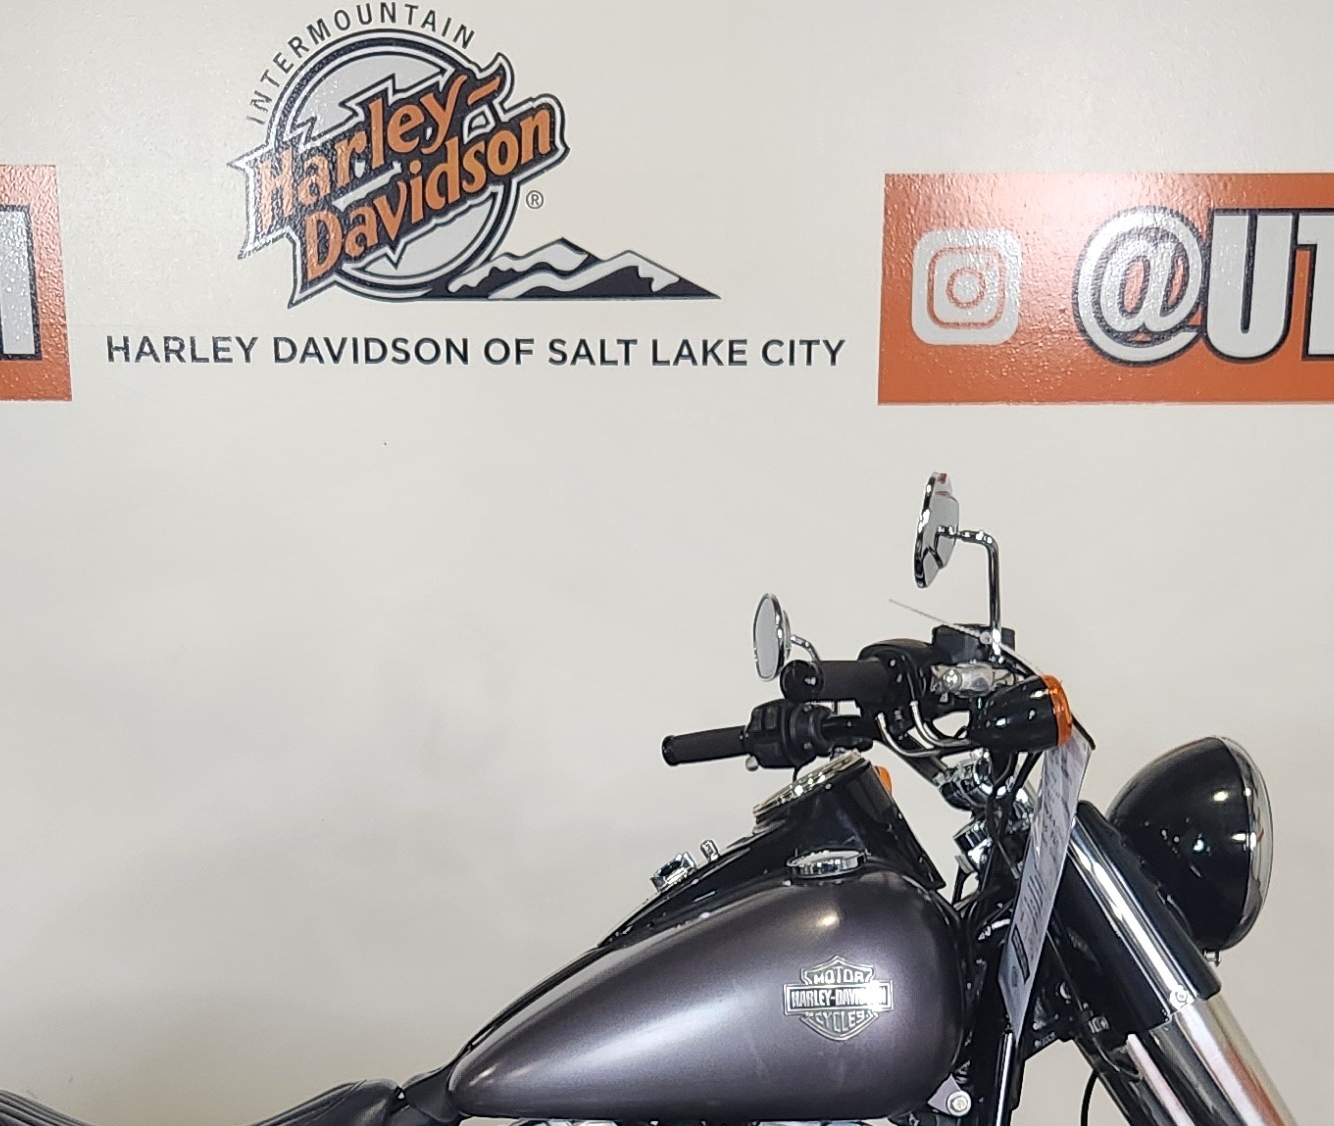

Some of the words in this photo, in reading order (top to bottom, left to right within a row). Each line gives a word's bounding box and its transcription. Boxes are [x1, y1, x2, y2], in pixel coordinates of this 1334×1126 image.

[246, 2, 475, 124] INTERMOUNTAIN
[304, 108, 551, 282] Davidson
[107, 335, 258, 363] HARLEY
[273, 336, 469, 365] DAVIDSON
[483, 337, 535, 366] OF
[547, 338, 638, 366] SALT
[651, 338, 748, 366] LAKE
[761, 338, 846, 366] CITY
